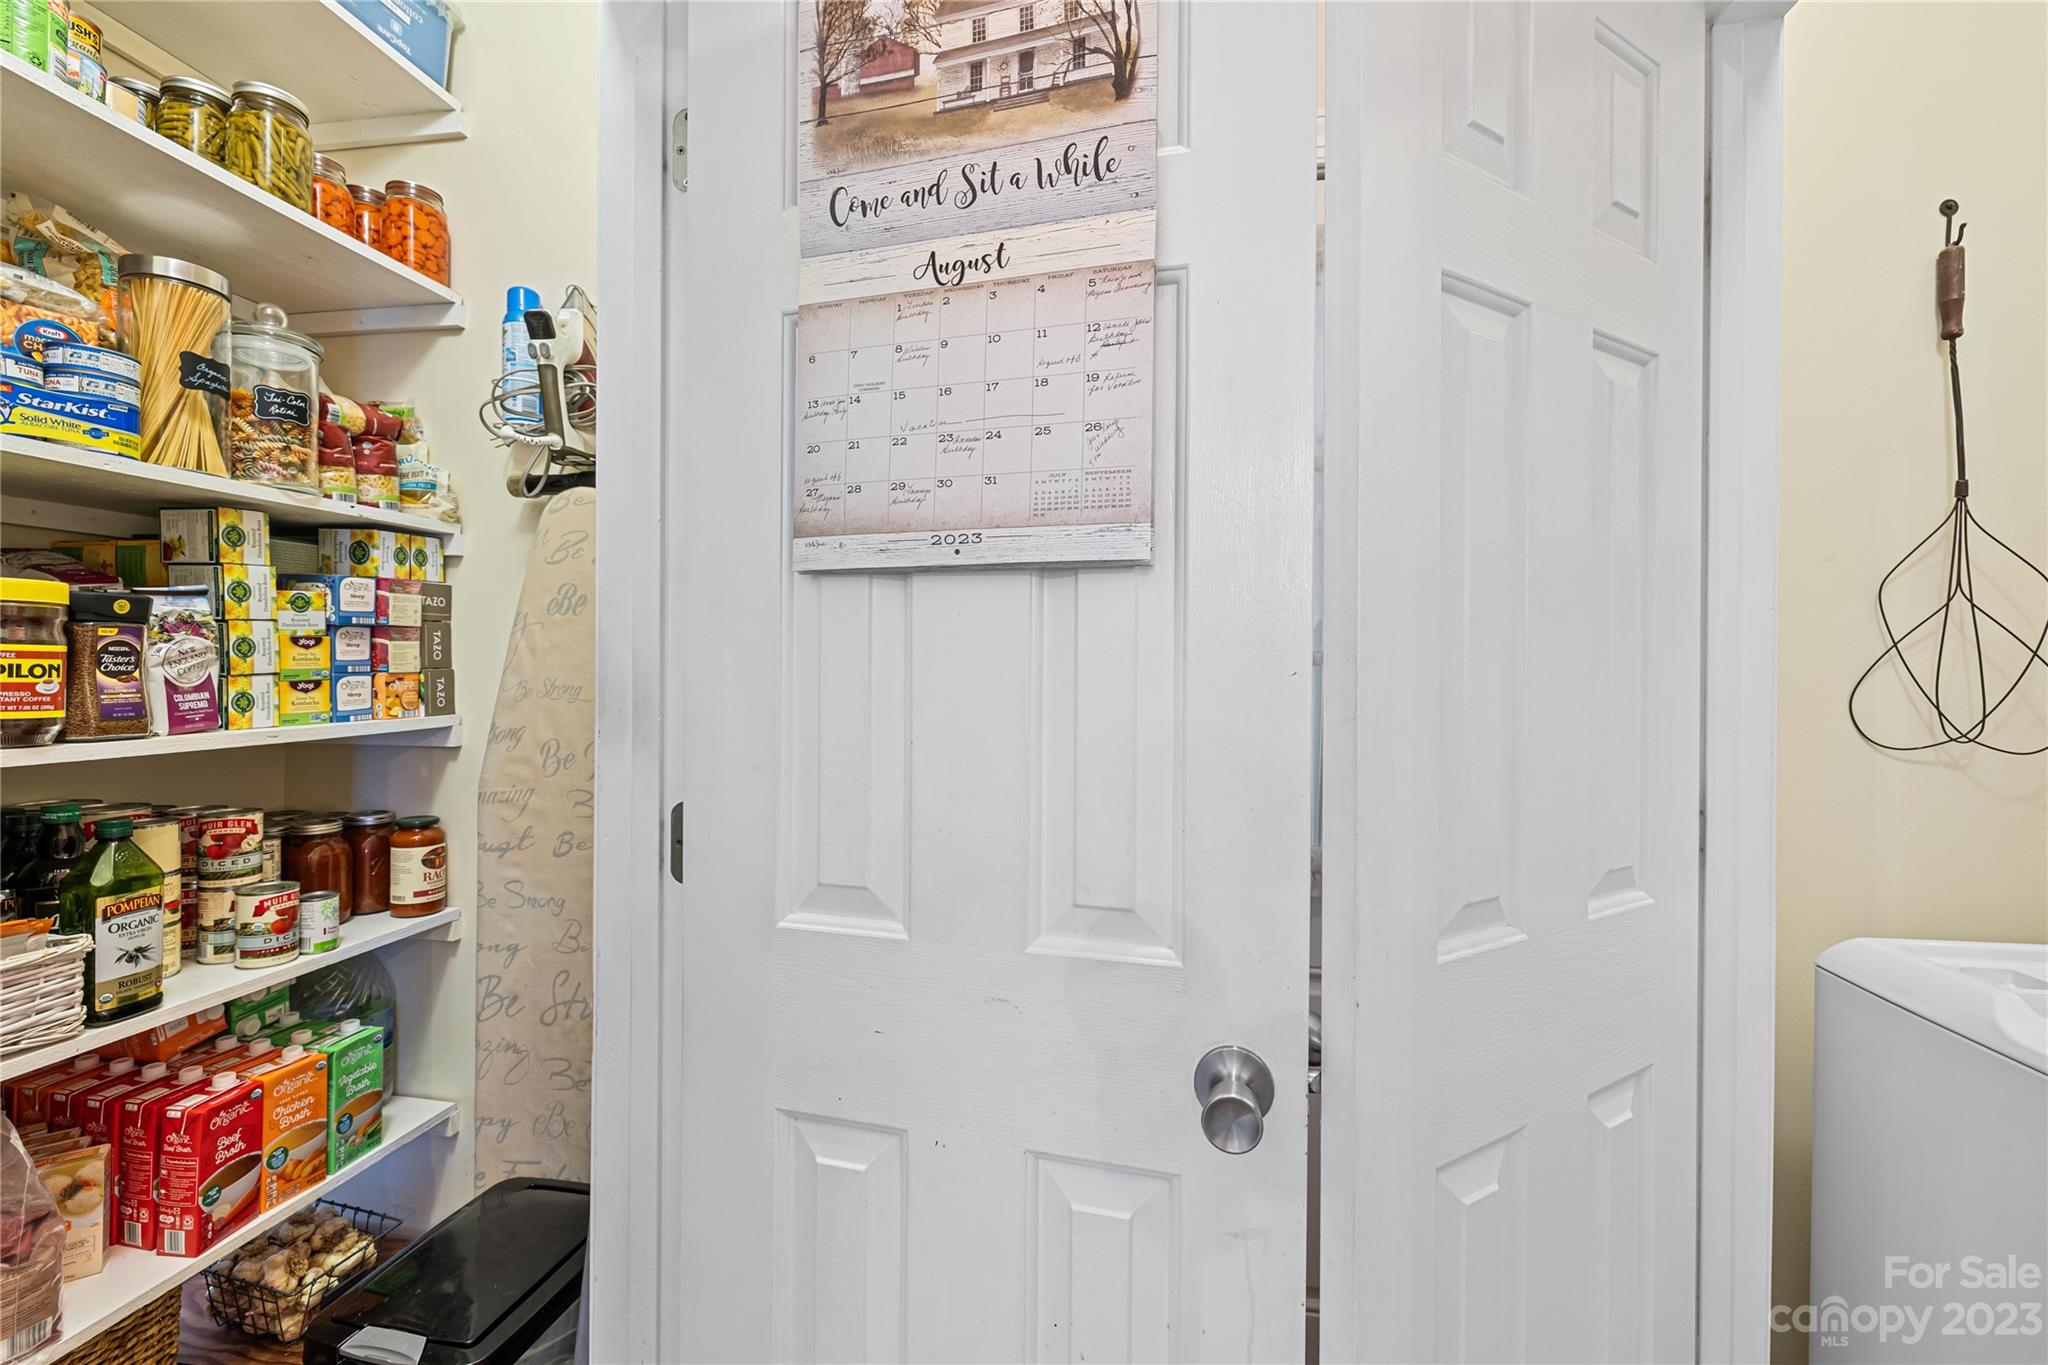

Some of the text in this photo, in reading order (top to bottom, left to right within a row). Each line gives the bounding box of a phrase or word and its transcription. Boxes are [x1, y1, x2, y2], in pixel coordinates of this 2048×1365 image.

[829, 135, 1122, 227] Come and Sit a While
[913, 242, 1010, 286] August
[904, 290, 934, 298] TUESDAY
[992, 278, 1031, 287] THURSDAY
[1047, 272, 1074, 280] FRIDAY
[1092, 265, 1133, 274] SATURDAY
[897, 304, 902, 312] 1
[942, 297, 950, 305] 2
[988, 291, 997, 300] 3
[1037, 284, 1046, 293] 4
[1088, 278, 1097, 287] 5
[42, 328, 62, 338] Kraft
[808, 355, 816, 364] 6
[895, 345, 903, 354] 8
[940, 340, 948, 348] 9
[987, 334, 1001, 343] 10
[1036, 329, 1048, 338] 11
[1087, 323, 1101, 332] 12
[18, 366, 39, 379] TUNA
[45, 376, 61, 386] UNA
[808, 400, 820, 408] 13
[849, 396, 861, 404] 14
[893, 391, 906, 400] 15
[938, 387, 952, 396] 16
[985, 382, 1000, 391] 17
[1034, 378, 1049, 387] 18
[1086, 373, 1100, 382] 19
[17, 392, 109, 419] StarKist
[268, 404, 298, 417] Rotini
[20, 412, 82, 430] Solid White
[806, 445, 820, 454] 20
[848, 441, 860, 450] 21
[892, 437, 907, 446] 22
[938, 433, 954, 443] 23
[985, 431, 1001, 440] 24
[1034, 426, 1052, 436] 25
[1085, 422, 1101, 432] 26
[806, 488, 819, 497] 27
[847, 485, 862, 494] 28
[890, 482, 906, 491] 29
[937, 479, 953, 488] 30
[984, 476, 997, 485] 31
[544, 530, 588, 565] Be
[930, 532, 983, 546] 2023
[421, 596, 446, 607] TAZO
[432, 630, 442, 661] TAZO
[100, 653, 136, 664] Taster's
[173, 691, 210, 702] COLOMBIAN
[436, 677, 446, 707] TAZO
[178, 700, 209, 711] SUPREMO
[488, 722, 526, 751] trong
[540, 738, 577, 777] Be
[202, 820, 252, 830] MUIR GLEN
[202, 857, 251, 867] DICED
[107, 895, 160, 917] POMPEIAN
[264, 895, 289, 908] MUIR
[108, 913, 159, 934] ORGANIC
[118, 926, 153, 938] EXTRA VIRGIN
[264, 931, 297, 944] DICE
[118, 973, 153, 989] ROBUST
[477, 974, 526, 1023] Be
[338, 1063, 377, 1087] Vegetable
[345, 1078, 371, 1097] Broth
[210, 1101, 254, 1130] Organic
[273, 1095, 315, 1120] Chicken
[279, 1108, 313, 1129] Broth
[217, 1128, 242, 1150] Beef
[215, 1139, 246, 1164] Broth
